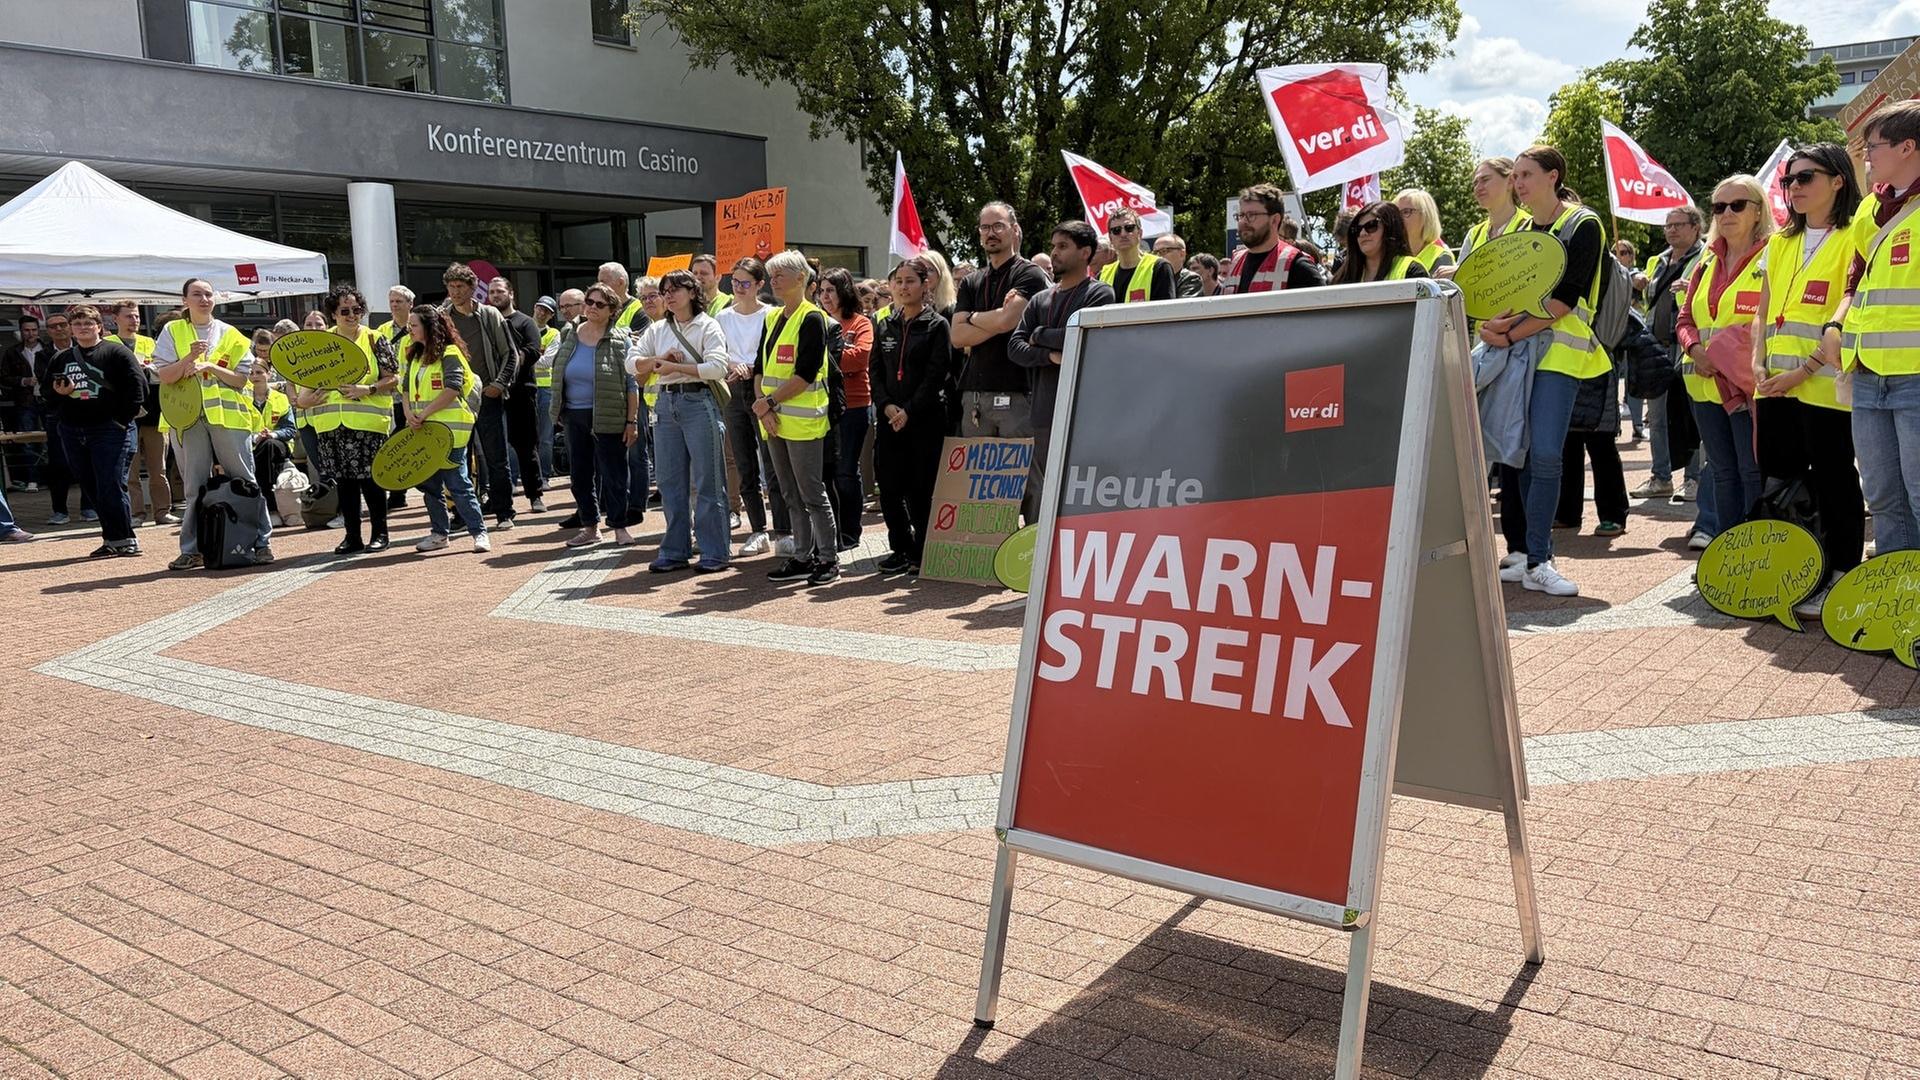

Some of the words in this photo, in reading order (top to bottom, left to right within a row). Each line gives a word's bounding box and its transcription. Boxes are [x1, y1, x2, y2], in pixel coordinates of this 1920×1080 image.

[427, 124, 627, 168] Konferenzzentrum
[638, 147, 699, 174] Casino
[1299, 114, 1378, 155] ver.di
[265, 271, 314, 283] Fils-Neckar-Alb
[1289, 403, 1339, 419] ver.di
[965, 443, 1032, 471] MEDIZIN
[969, 474, 1028, 500] TECHNIK
[1065, 465, 1203, 509] Heute
[1718, 526, 1754, 552] Politik
[1761, 522, 1790, 545] ohne
[1059, 529, 1373, 625] WARN-
[1738, 584, 1781, 615] dringend
[1781, 557, 1816, 596] Physio
[1865, 576, 1897, 594] HAT
[1873, 593, 1916, 621] bald
[1038, 609, 1362, 728] STREIK
